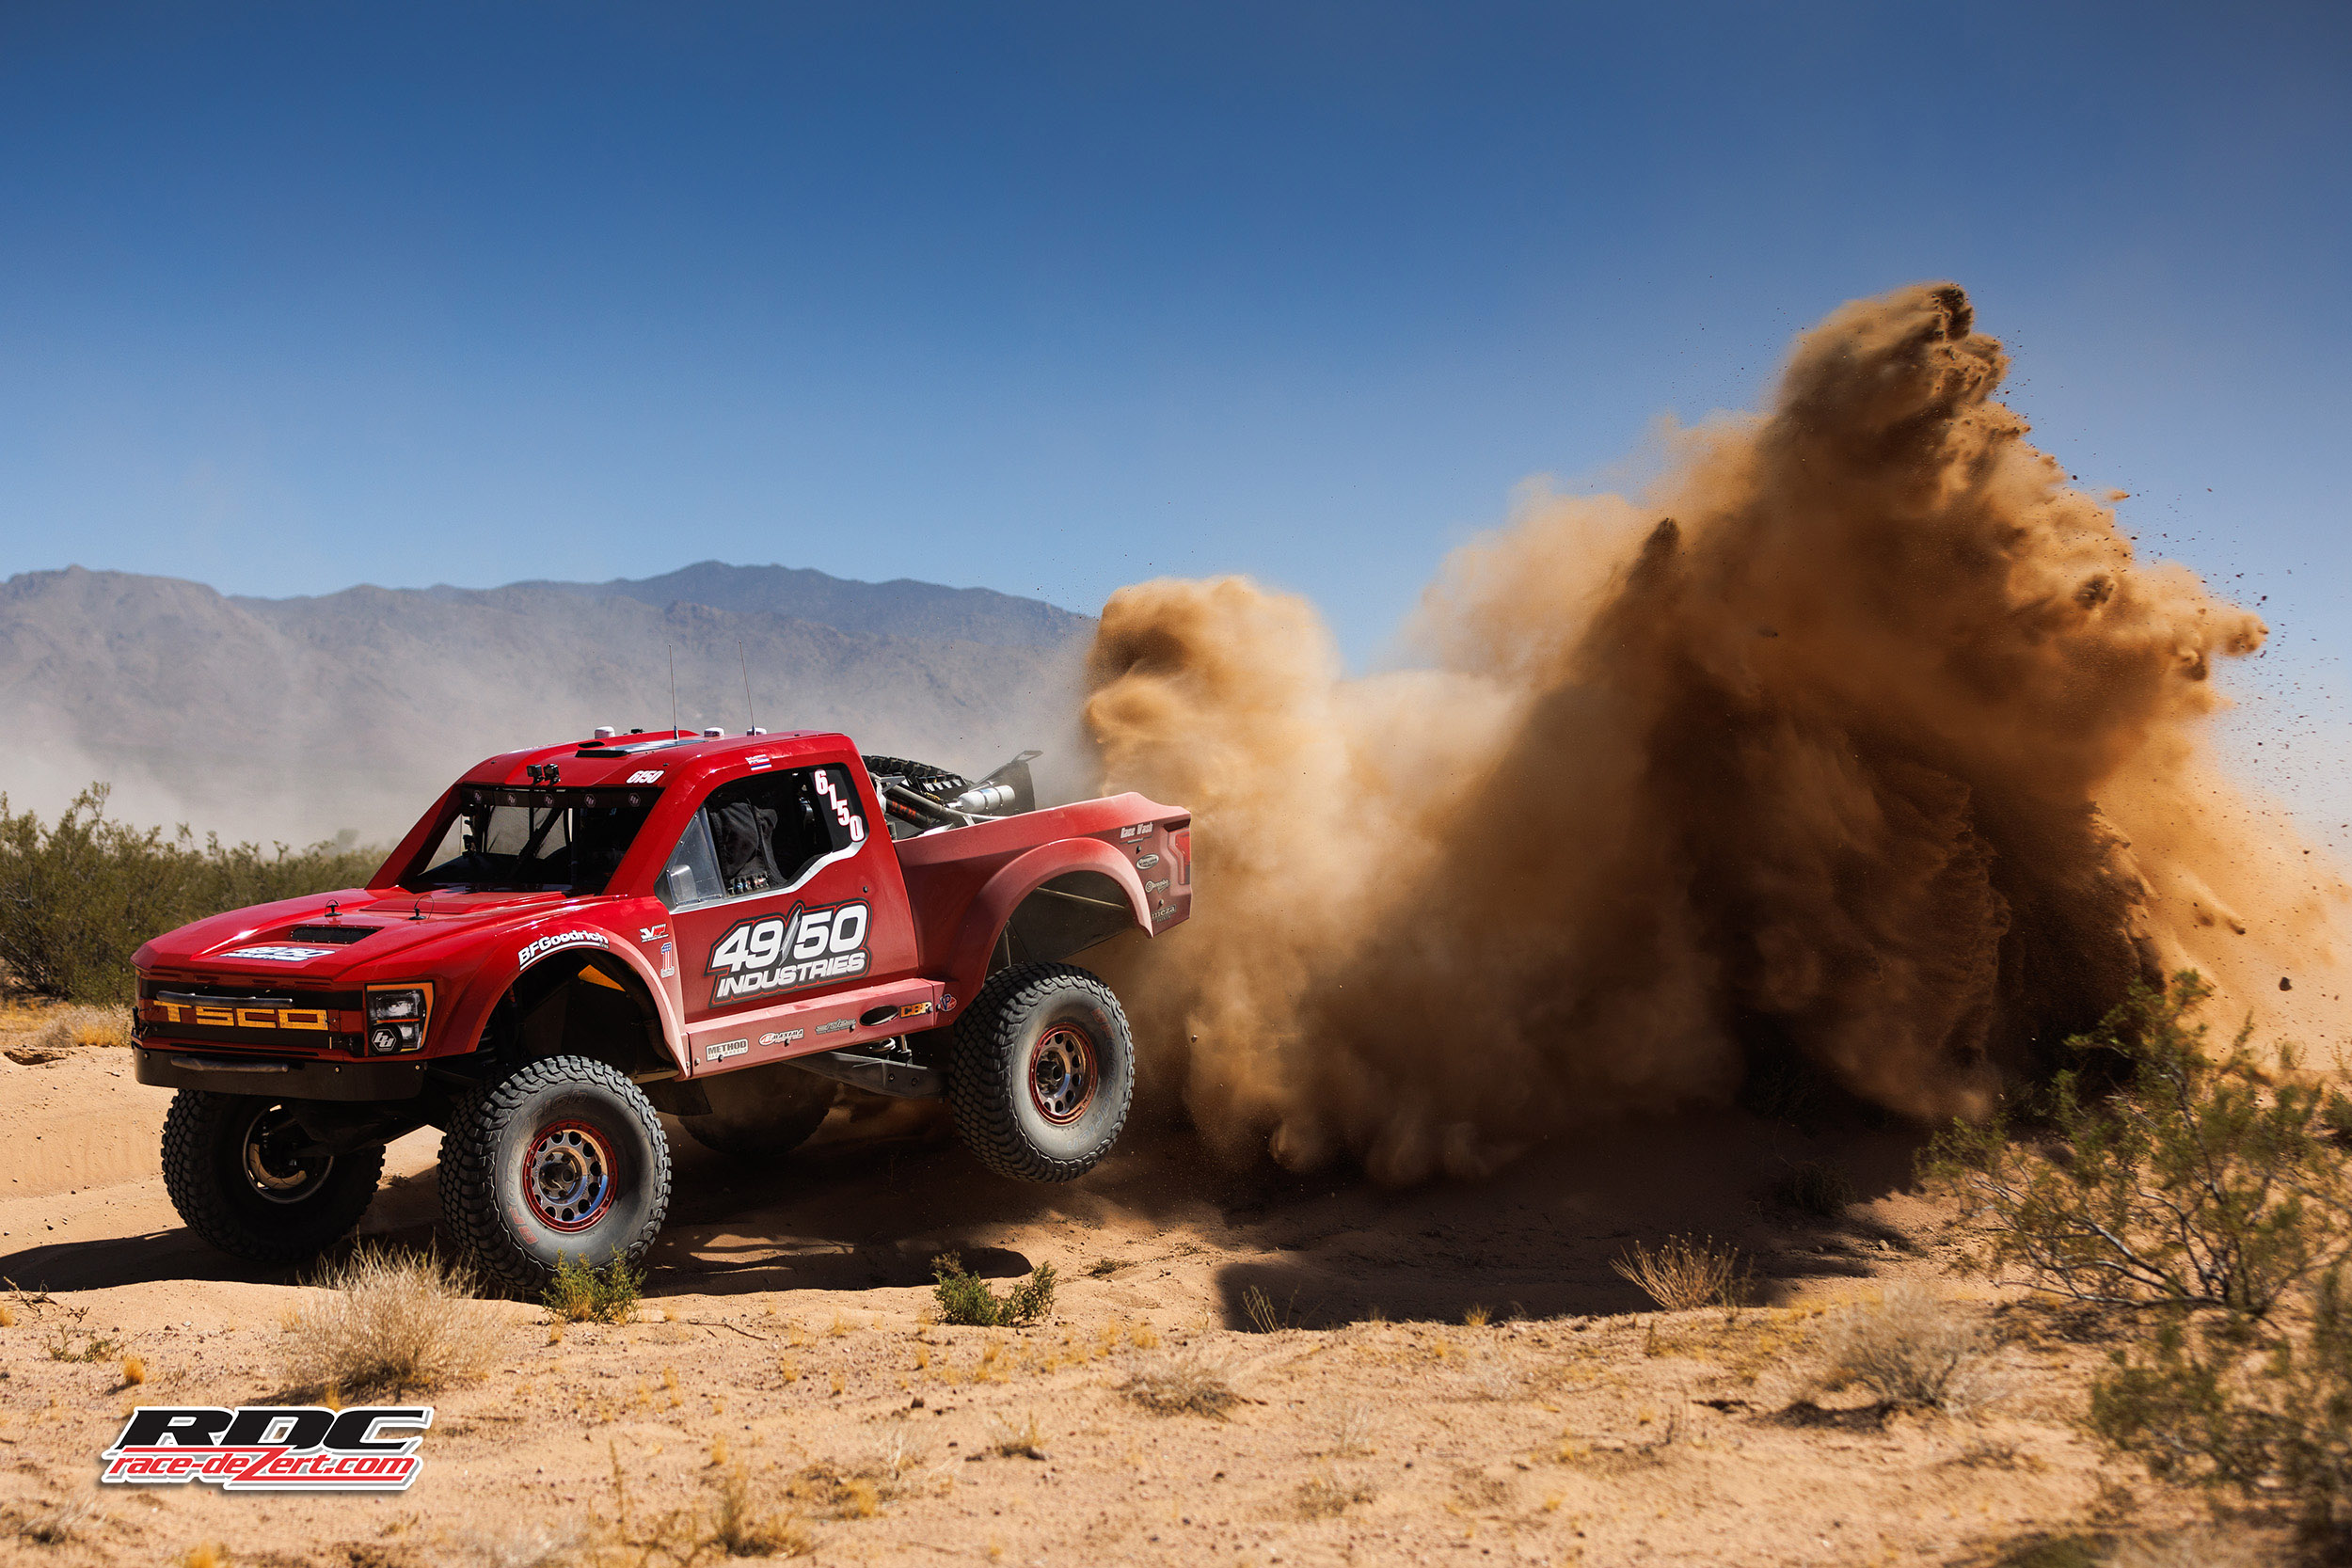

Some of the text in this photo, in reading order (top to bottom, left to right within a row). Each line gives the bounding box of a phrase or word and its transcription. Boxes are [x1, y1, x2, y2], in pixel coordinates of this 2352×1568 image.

[626, 769, 665, 784] 6150
[814, 768, 865, 843] 6150
[517, 929, 610, 966] BFGoodrich
[711, 904, 868, 973] 49/50
[716, 952, 866, 998] INDUSTRIES
[153, 1000, 329, 1031] TSCO
[940, 993, 952, 1011] VP
[707, 1040, 747, 1054] METHOD
